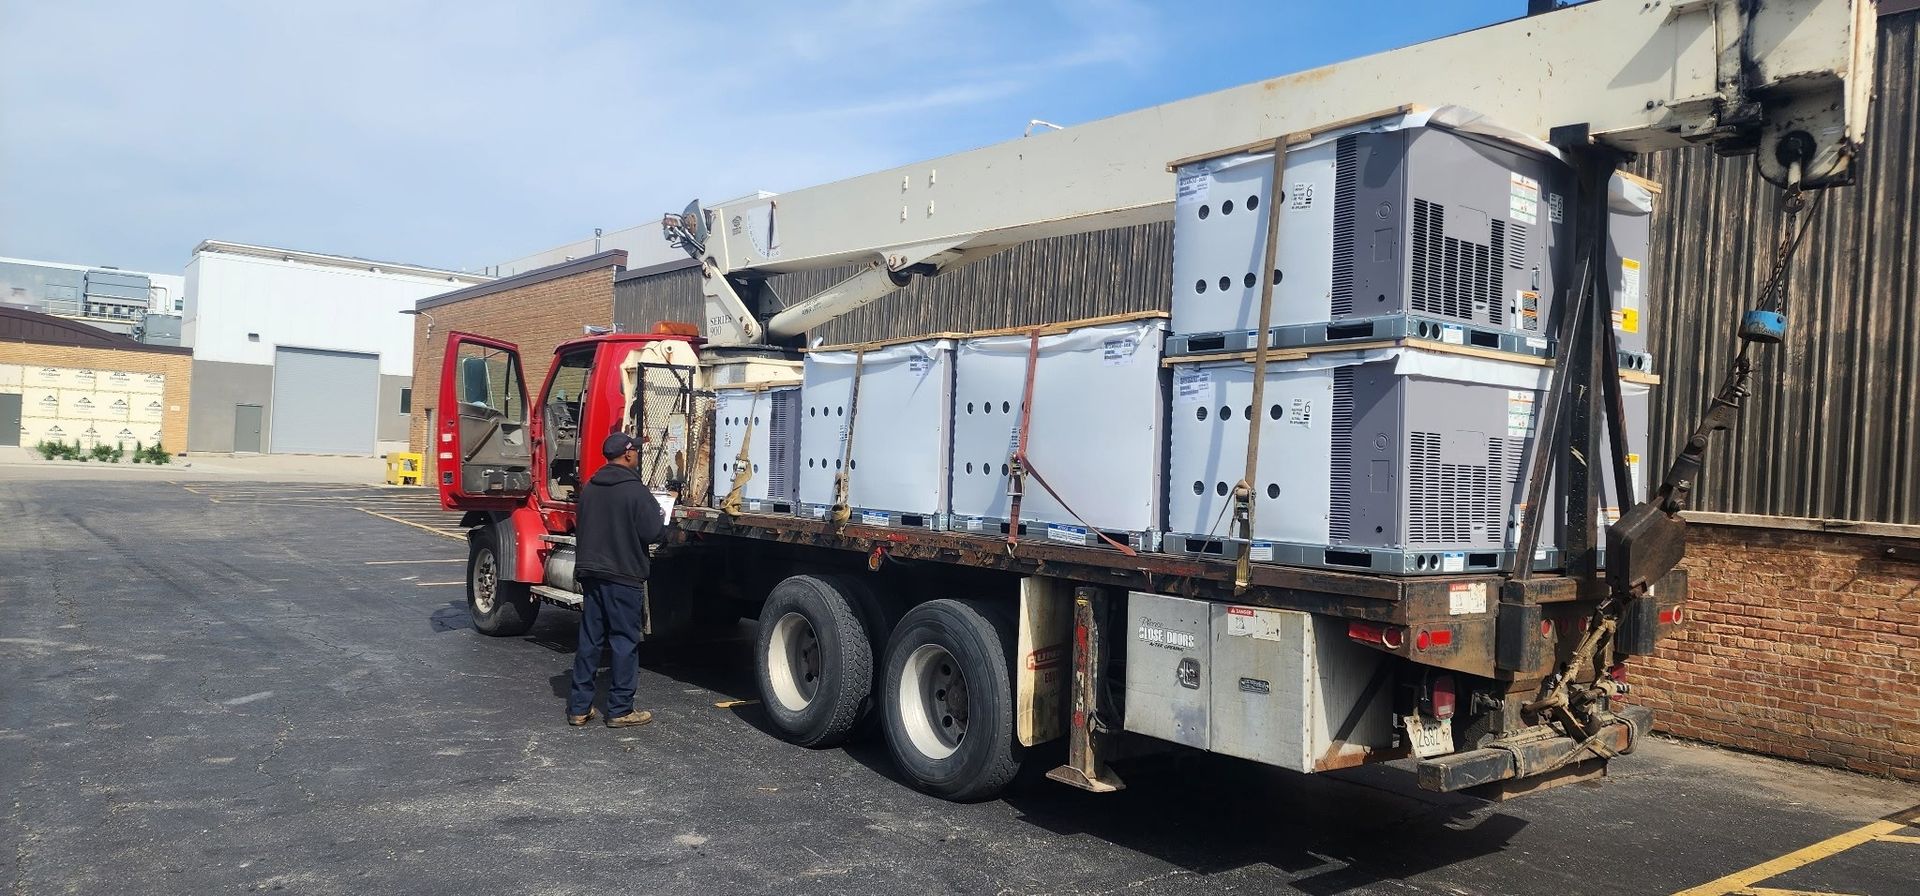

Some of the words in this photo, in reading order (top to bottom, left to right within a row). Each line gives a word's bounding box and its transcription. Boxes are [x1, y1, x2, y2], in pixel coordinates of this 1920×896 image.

[711, 314, 732, 325] SERIES
[710, 326, 722, 336] 900
[1236, 608, 1253, 616] DANGER
[1139, 626, 1164, 642] CLOSE
[1166, 631, 1195, 648] DOORS
